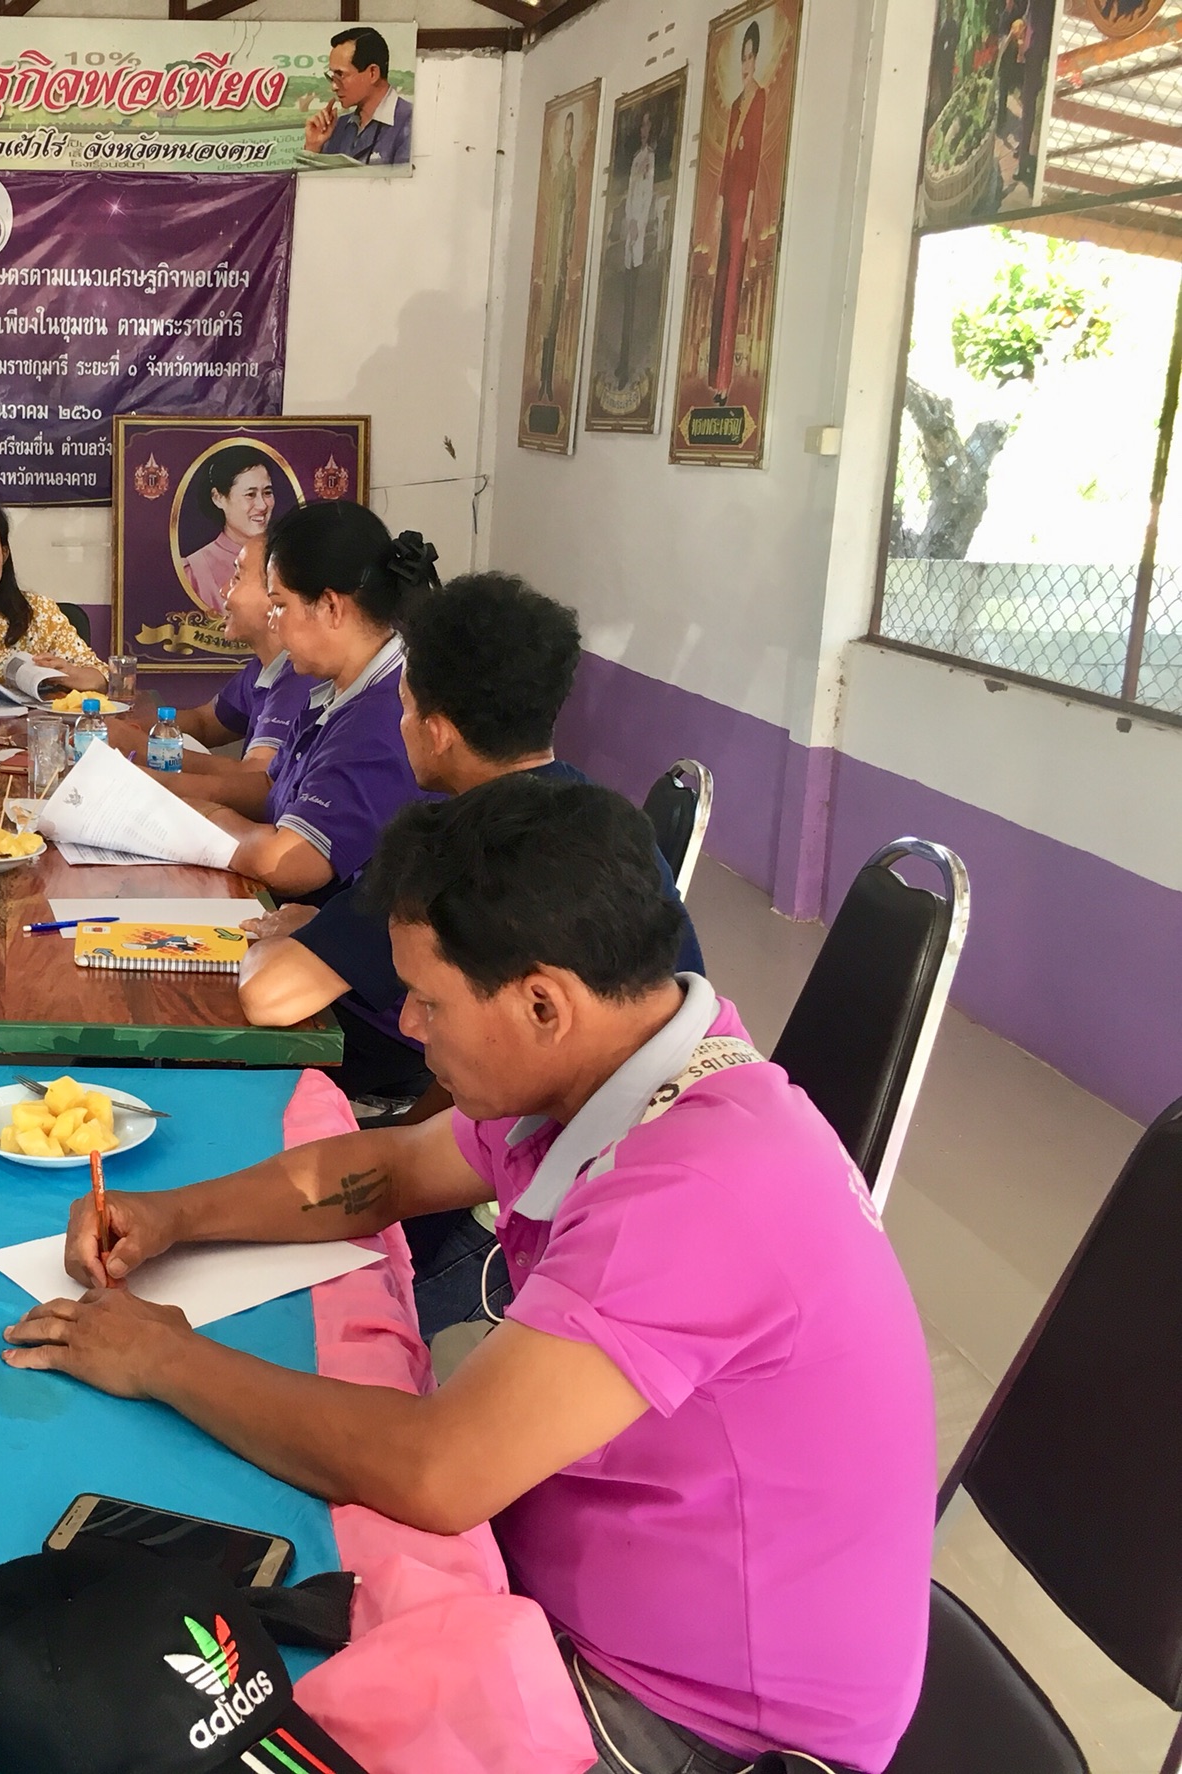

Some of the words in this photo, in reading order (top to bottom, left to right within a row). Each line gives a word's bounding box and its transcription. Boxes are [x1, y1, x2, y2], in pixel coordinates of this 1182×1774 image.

[66, 51, 142, 67] 10%
[83, 131, 276, 161] จังหวัดหนองคาย
[118, 310, 243, 337] ตามพระราชดำริ
[76, 349, 119, 376] ระยะที่
[146, 355, 259, 378] จังหวัดหนองคาย
[58, 405, 102, 420] ๒๕๖๐
[691, 410, 743, 443] ทรงพระเจริญ
[189, 1670, 274, 1750] adidas
